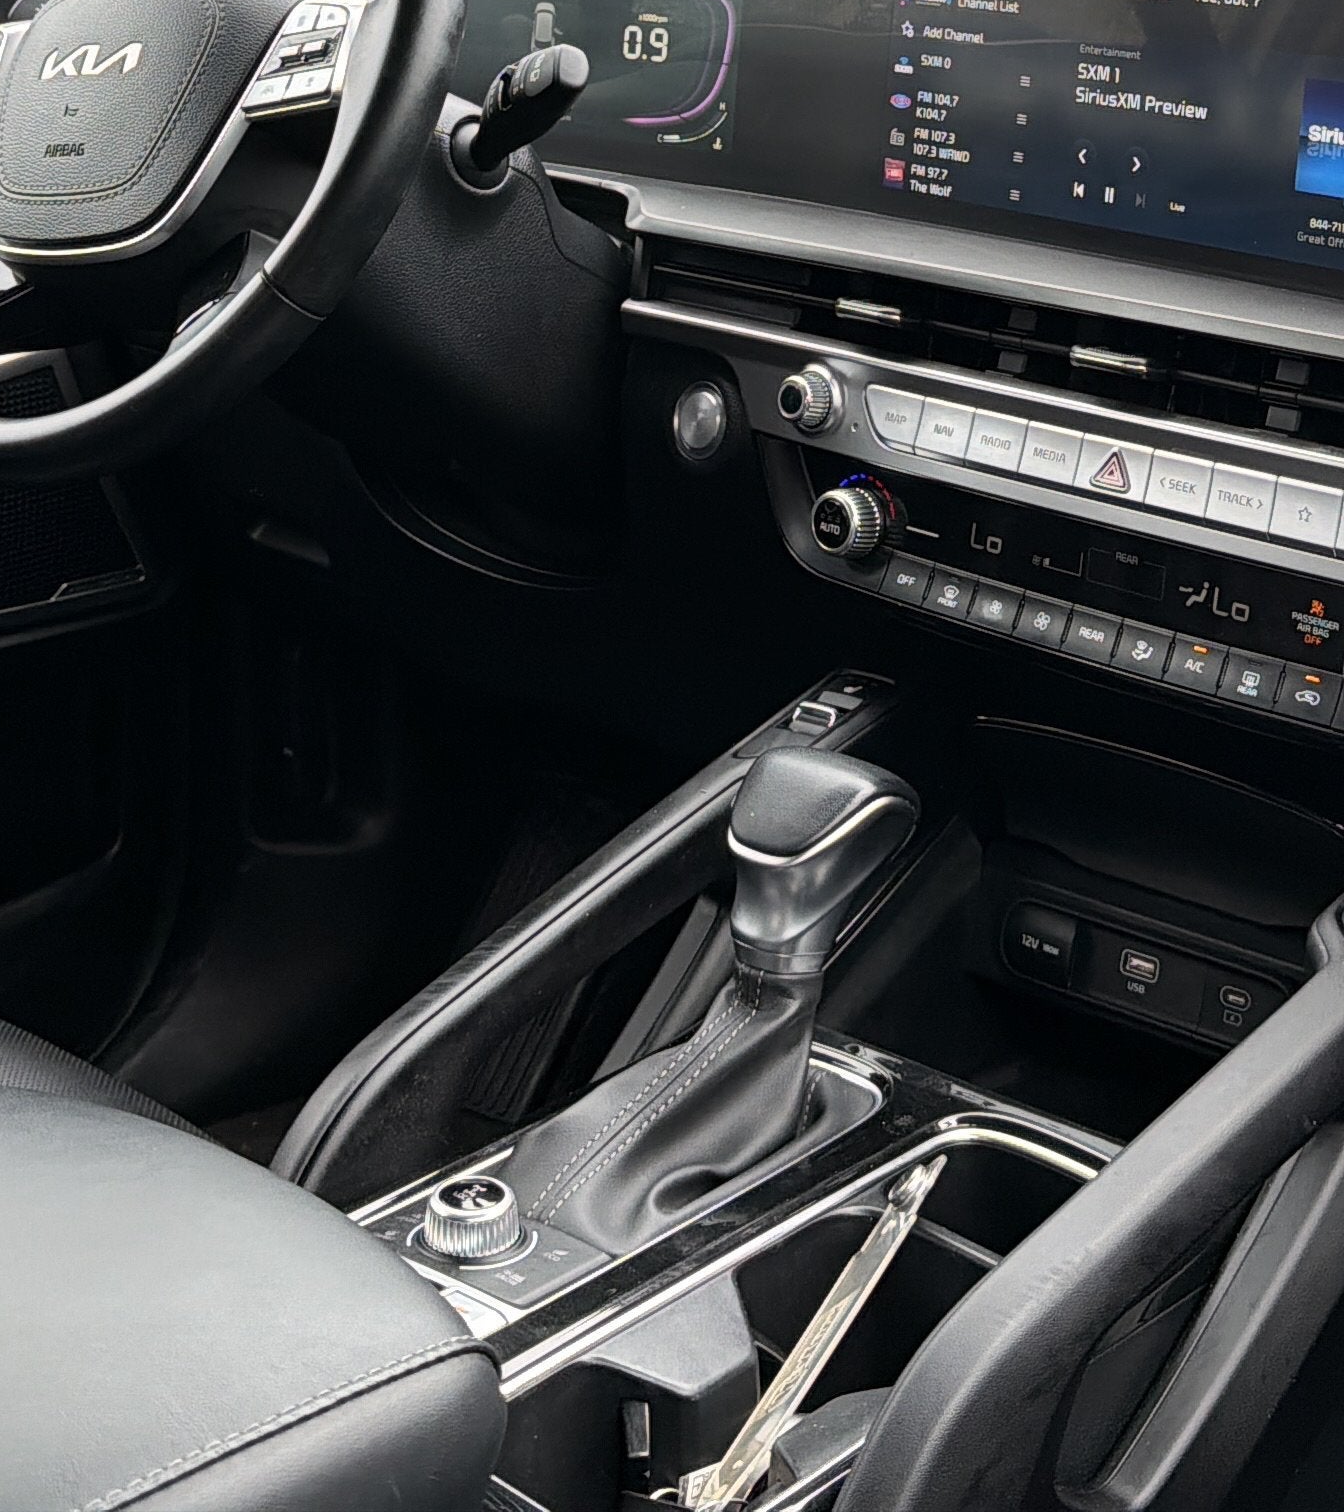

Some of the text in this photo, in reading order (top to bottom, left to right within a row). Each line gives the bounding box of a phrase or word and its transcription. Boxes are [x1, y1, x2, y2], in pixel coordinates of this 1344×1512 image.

[999, 1, 1020, 14] List
[923, 25, 984, 44] Add Channel
[623, 25, 669, 63] 0.9
[1079, 43, 1142, 61] Entertainment
[40, 42, 143, 80] KIA
[920, 54, 943, 68] SXM
[1077, 63, 1121, 83] SXM 1
[917, 90, 933, 103] FM
[934, 93, 960, 108] 104.7
[1075, 87, 1208, 120] SiriusXM Preview
[915, 106, 948, 122] K104.7
[914, 127, 956, 145] FM 107.3
[43, 142, 85, 159] AIRBAG
[913, 142, 971, 163] 107.3 WRWD
[910, 164, 926, 177] FM
[927, 167, 949, 181] 97.7
[909, 179, 953, 198] The Wolf
[1296, 231, 1326, 246] Great
[884, 411, 907, 425] MAP
[933, 423, 955, 437] NAV
[979, 434, 1012, 451] RADIO
[1032, 446, 1066, 464] MEDIA
[1168, 479, 1198, 495] SEEK
[1217, 489, 1254, 507] TRACK
[819, 522, 841, 536] AUTO
[1115, 551, 1139, 567] REAR
[896, 573, 917, 587] OFF
[1291, 611, 1340, 632] PASSENGER
[1078, 626, 1105, 643] REAR
[1296, 622, 1330, 639] AIR BAG
[1304, 634, 1322, 646] OFF
[1184, 658, 1206, 674] A/C
[1237, 685, 1259, 697] REAR
[1022, 933, 1040, 950] 12V
[1127, 980, 1146, 994] USB
